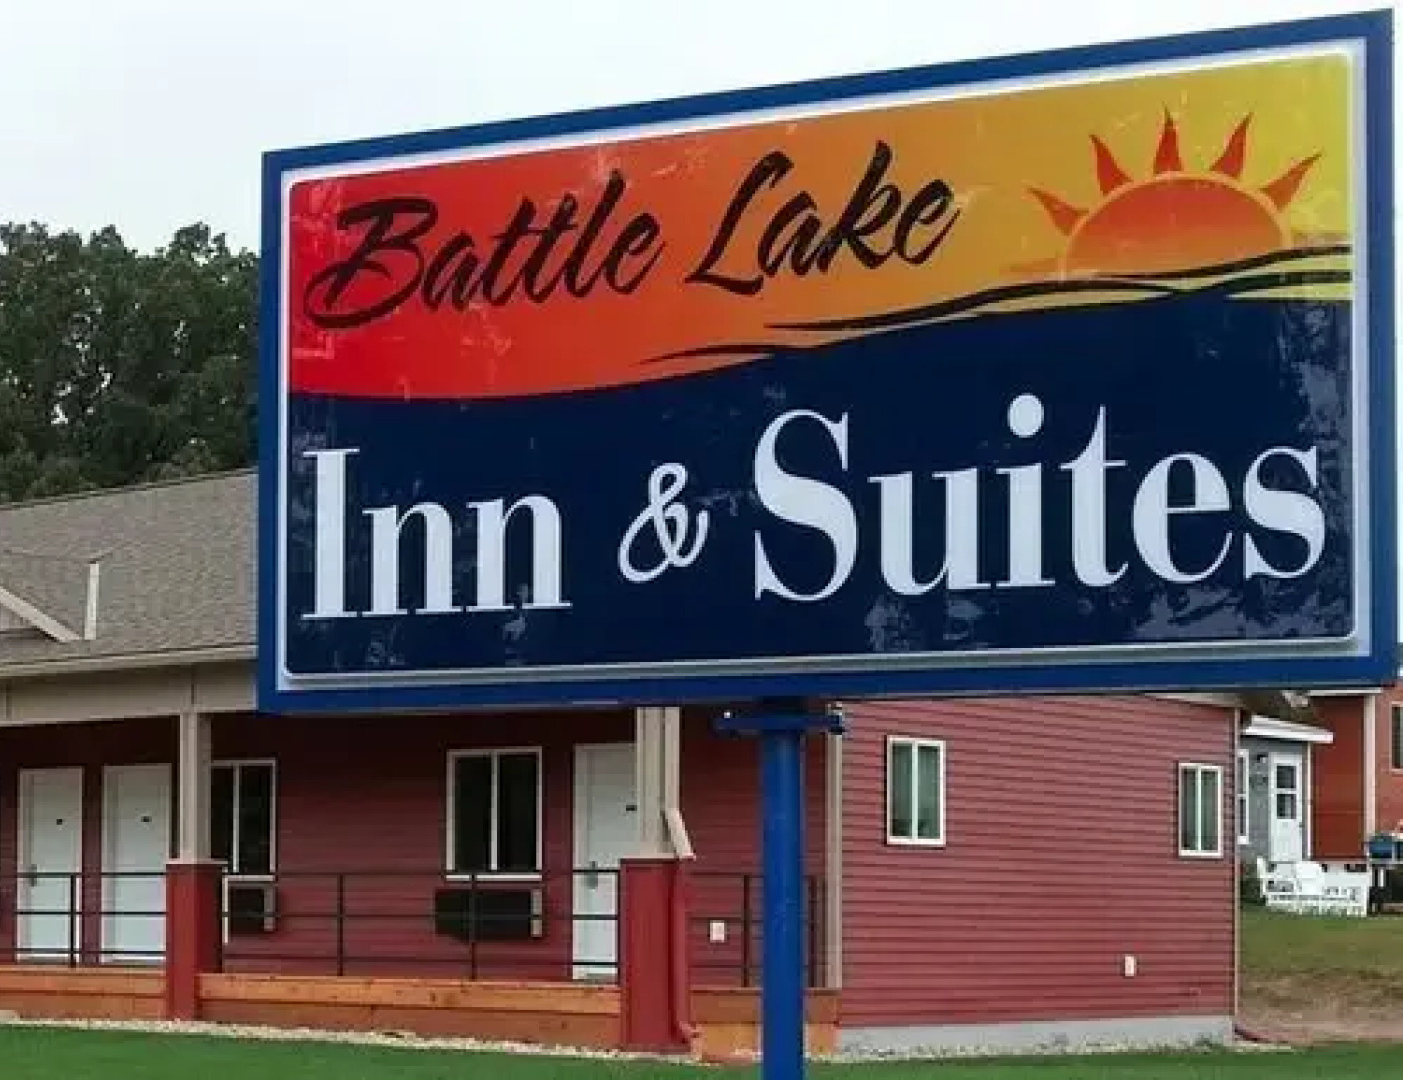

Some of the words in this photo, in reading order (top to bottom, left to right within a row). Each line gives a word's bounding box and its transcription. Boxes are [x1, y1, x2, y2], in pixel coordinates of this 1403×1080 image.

[303, 169, 664, 329] Battle
[685, 140, 961, 296] Lake
[302, 448, 572, 620] Inn
[617, 462, 711, 583] &
[754, 394, 1326, 602] Suites
